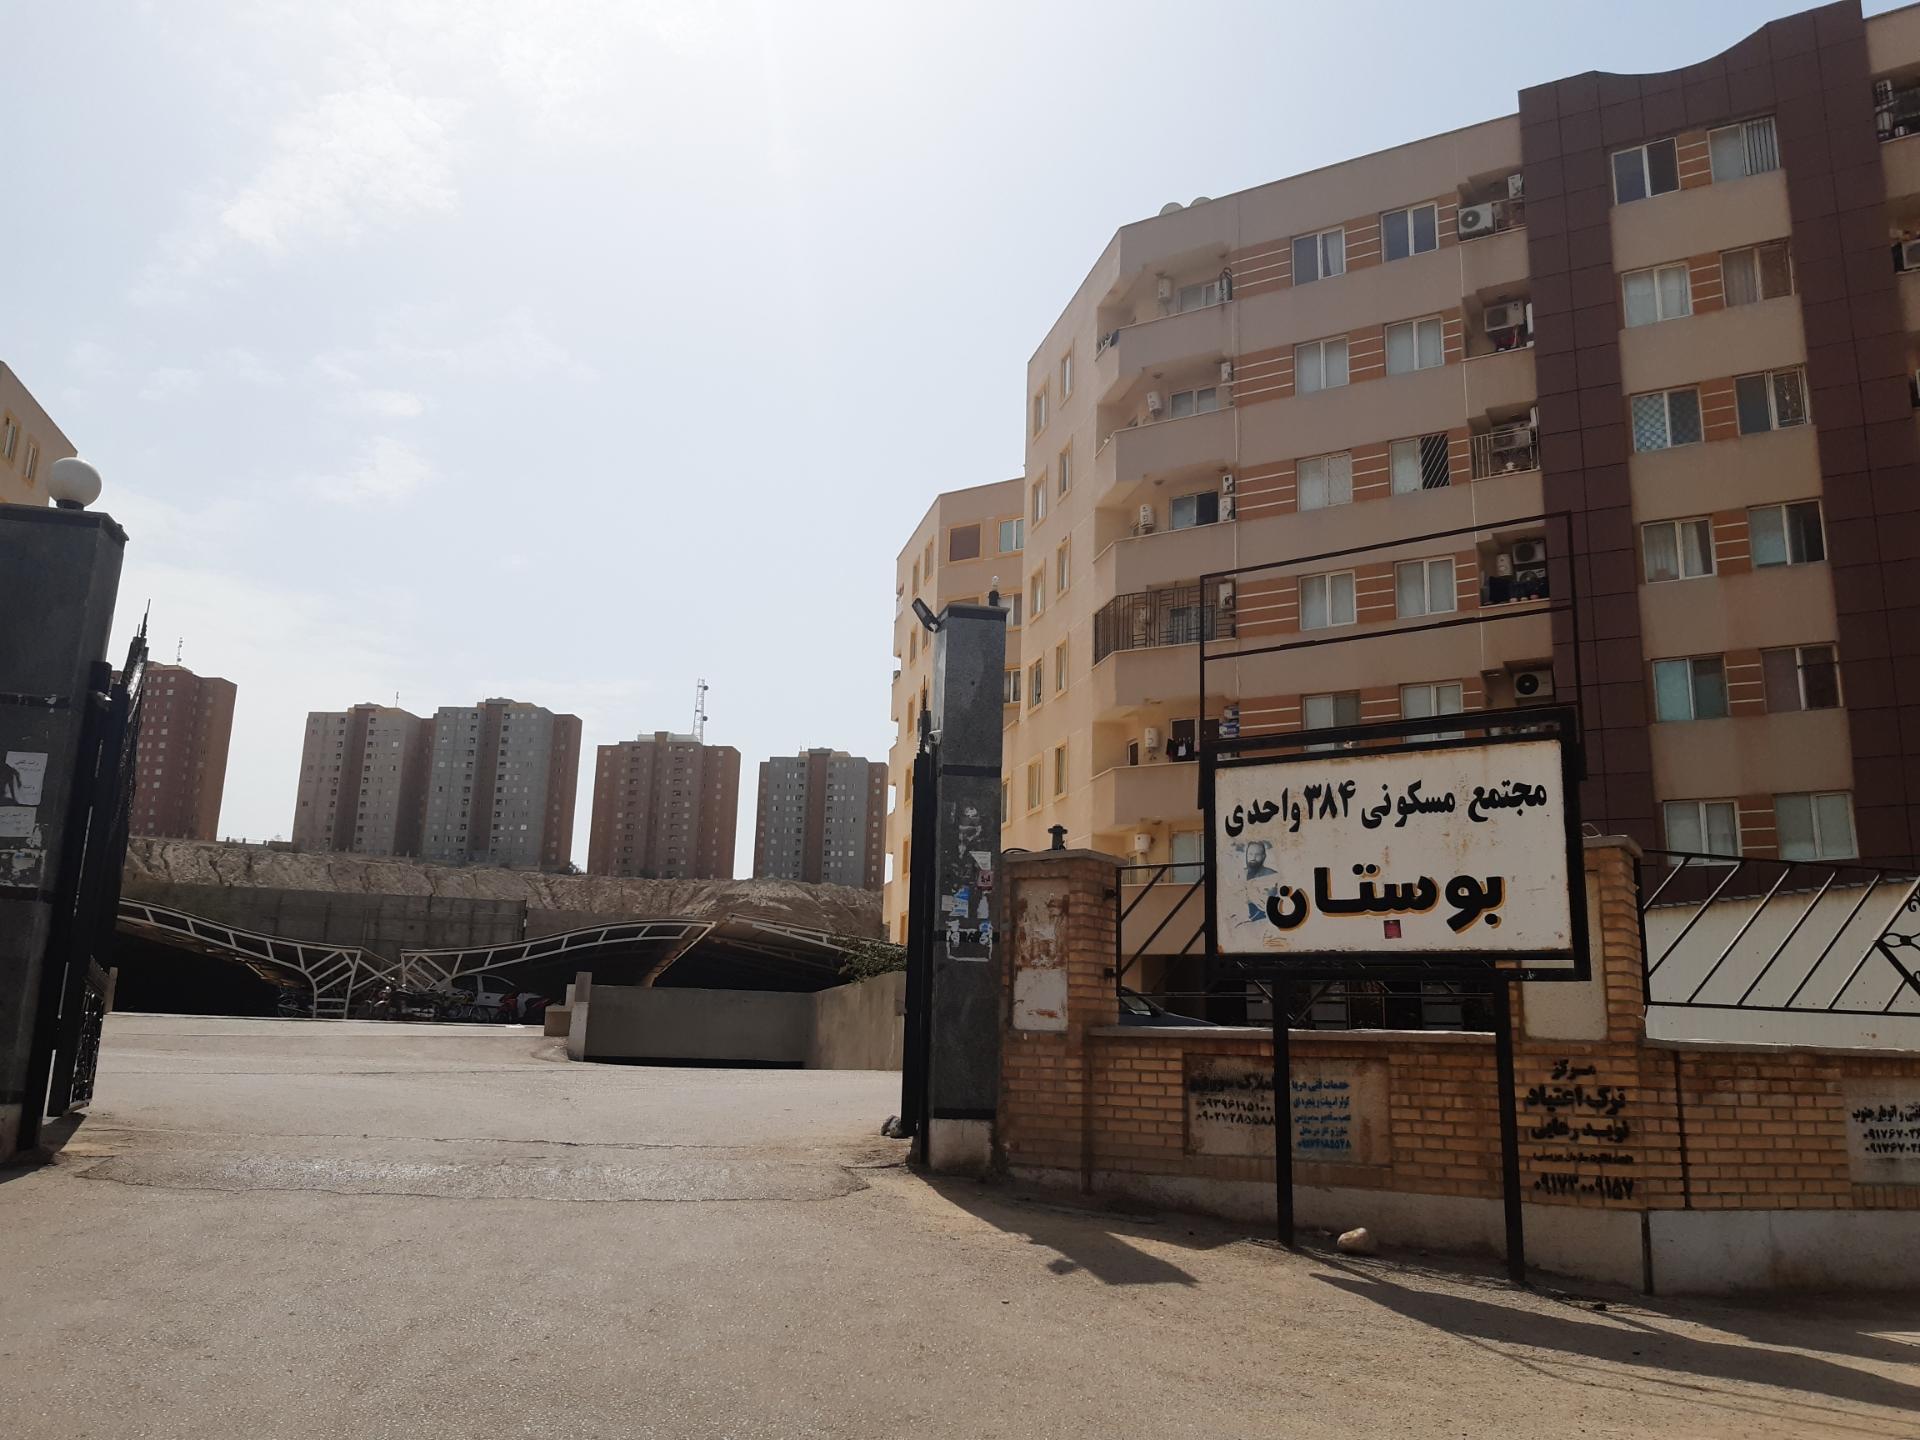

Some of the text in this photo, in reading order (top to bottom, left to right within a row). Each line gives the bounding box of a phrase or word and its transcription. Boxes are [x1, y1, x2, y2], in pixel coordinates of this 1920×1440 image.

[1225, 788, 1301, 837] واحدی
[1361, 780, 1456, 830] مسکونی
[1468, 779, 1547, 823] مجتمع
[1266, 863, 1505, 934] بوستان
[1551, 1059, 1597, 1080] مرکز
[1527, 1084, 1625, 1115] ترک اعتیاد
